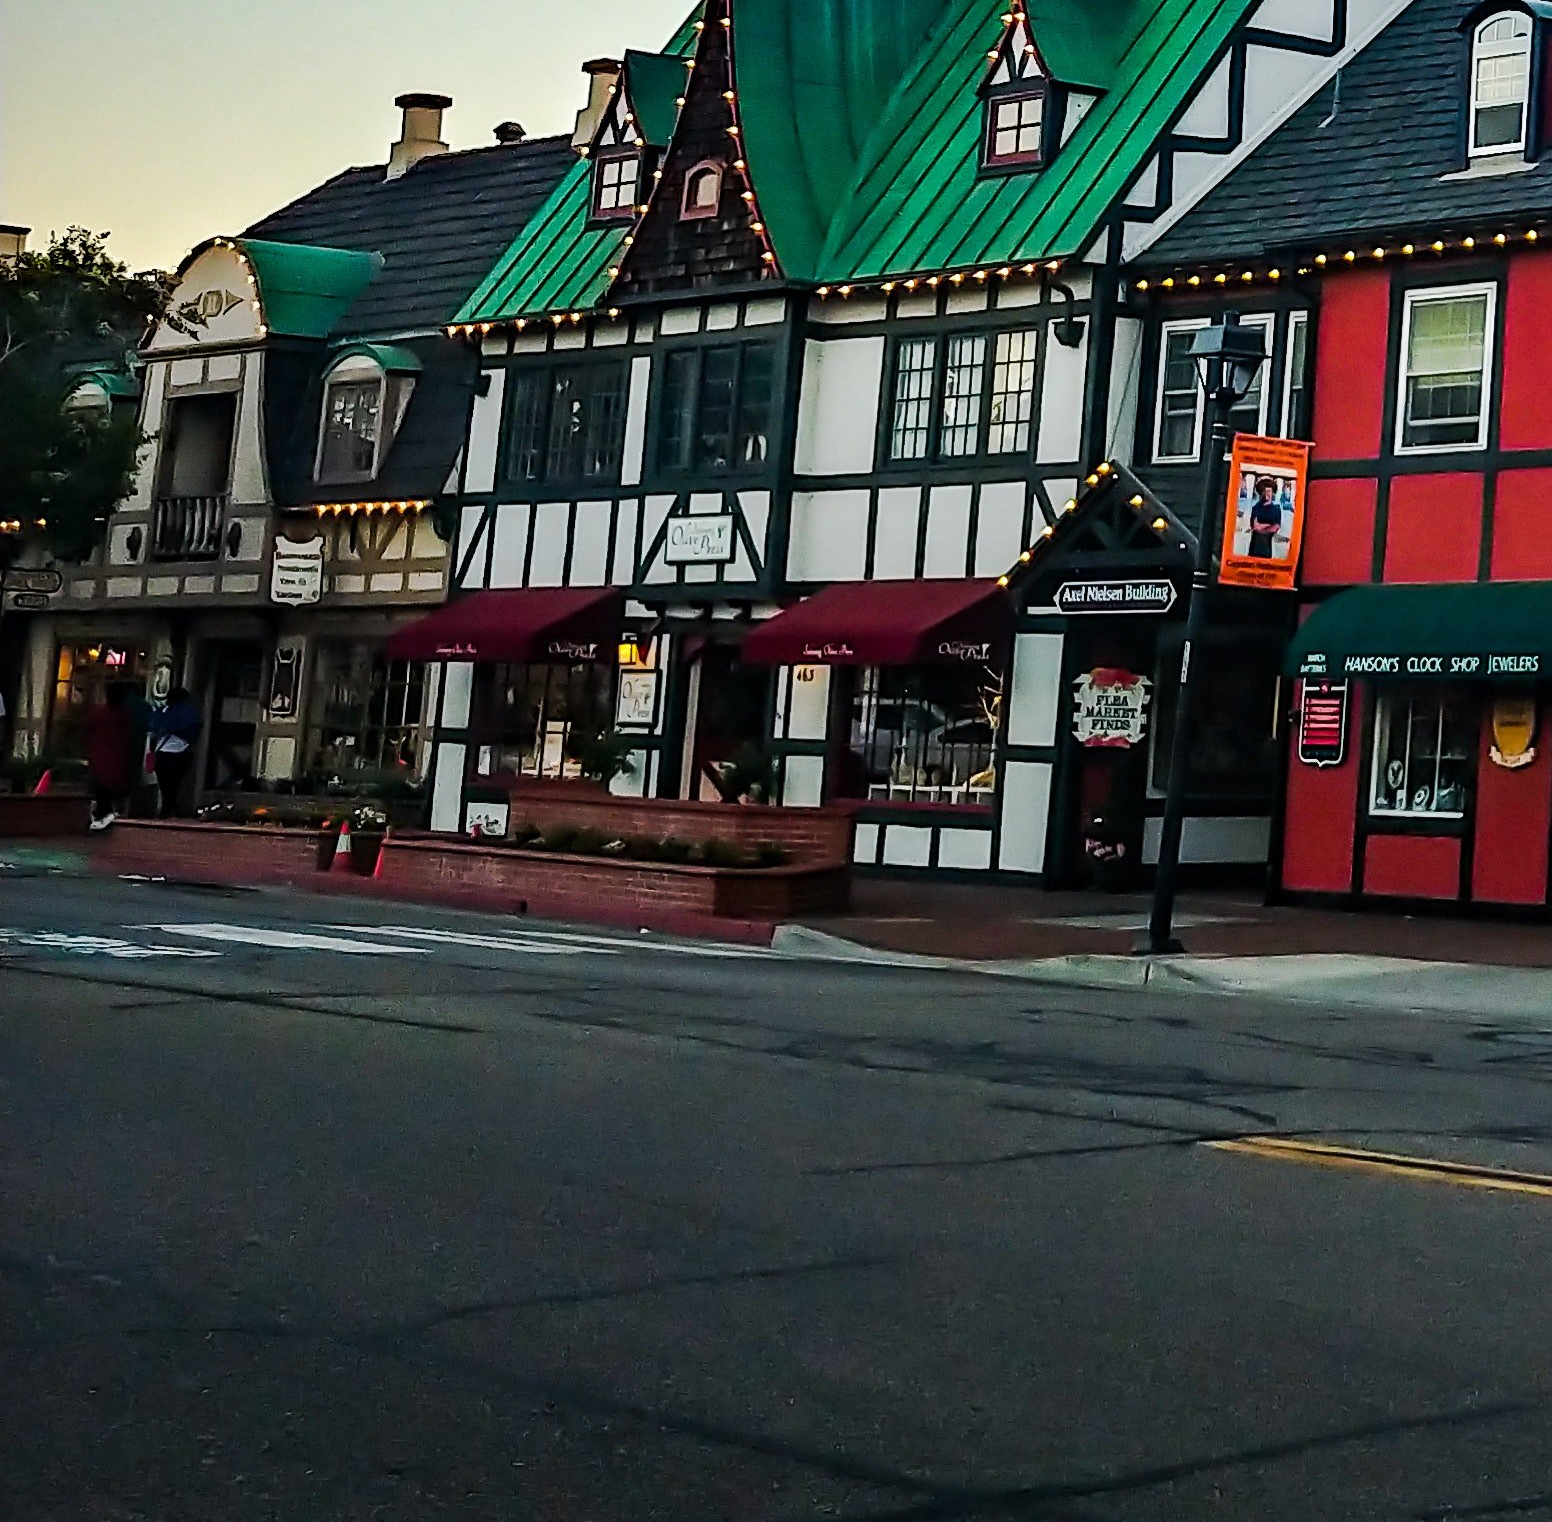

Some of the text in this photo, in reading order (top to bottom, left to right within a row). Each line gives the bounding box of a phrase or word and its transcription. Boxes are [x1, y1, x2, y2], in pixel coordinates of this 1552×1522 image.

[1062, 584, 1169, 603] Axel Nielsen Building
[1344, 656, 1400, 673] HANSON'S
[1406, 656, 1443, 673] CLOCK
[1450, 656, 1480, 673] SHOP
[1487, 654, 1539, 675] JEWELERS
[1096, 694, 1129, 707] FLEA
[1083, 706, 1138, 720] MARKET
[1091, 718, 1132, 731] FINDS
